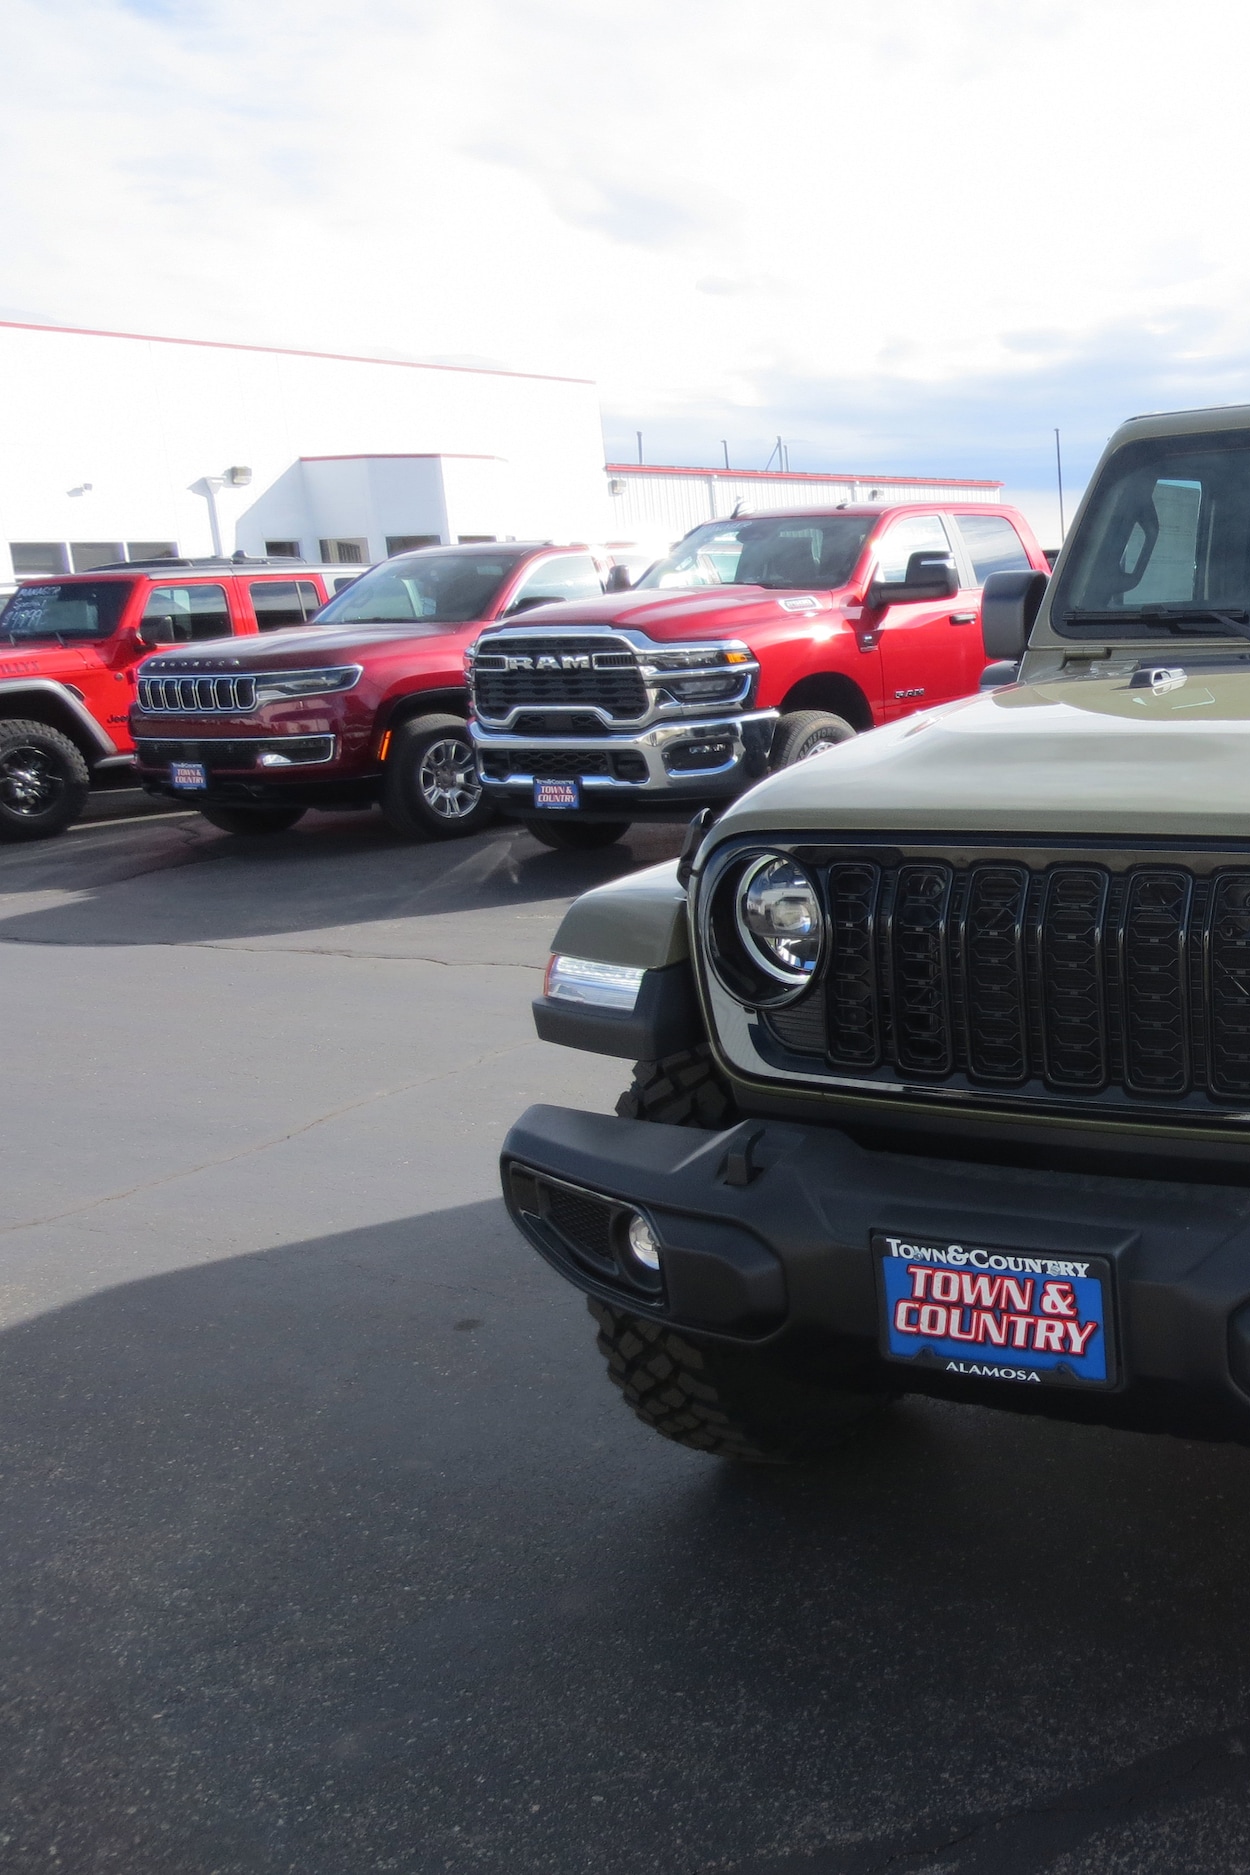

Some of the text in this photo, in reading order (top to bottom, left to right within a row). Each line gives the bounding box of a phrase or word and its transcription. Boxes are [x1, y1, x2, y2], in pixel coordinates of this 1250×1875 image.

[509, 656, 590, 669] RAM
[538, 794, 577, 803] COUNTRY
[540, 786, 565, 794] TOWN
[907, 1264, 1078, 1317] TOWN &
[894, 1299, 1097, 1355] COUNTRY
[946, 1361, 1042, 1383] ALAMOSA
